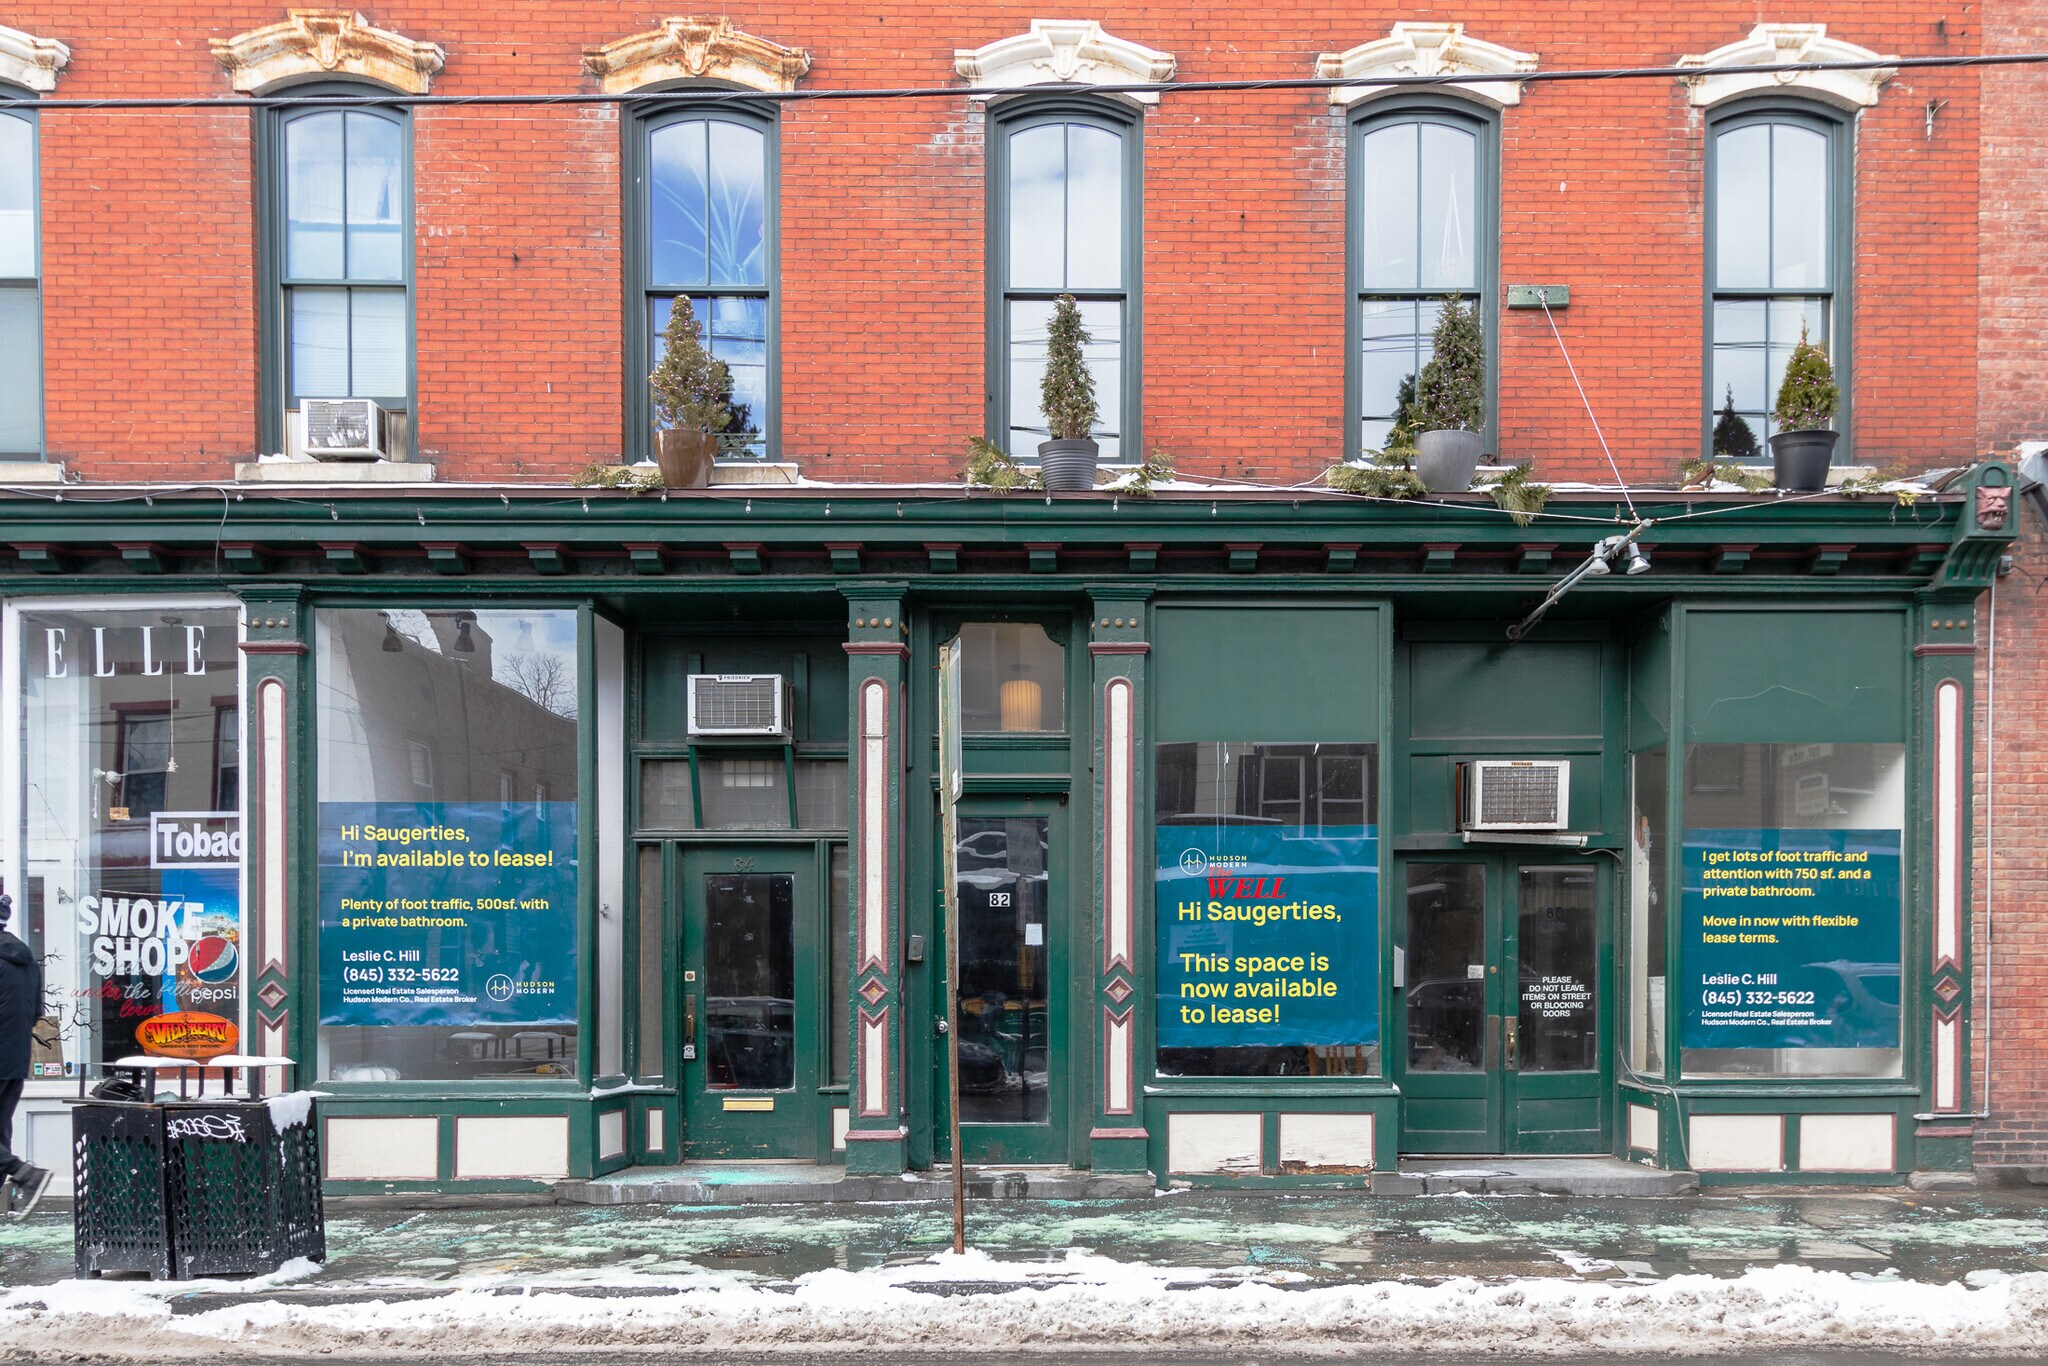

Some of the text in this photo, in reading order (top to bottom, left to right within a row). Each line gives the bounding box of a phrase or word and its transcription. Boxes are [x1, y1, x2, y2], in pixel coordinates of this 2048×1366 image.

[45, 625, 206, 677] ELLE
[341, 825, 469, 845] Hi Saugerties,
[343, 850, 553, 867] I'm available to lease!
[1703, 851, 1868, 864] I get lots of foot traffic and
[1703, 868, 1871, 879] attention with 750 sf. and a
[1207, 878, 1286, 898] WELL
[1703, 885, 1815, 899] private bathroom.
[341, 899, 549, 912] Plenty of foot traffic, 500sf. with
[991, 894, 1009, 906] 82
[79, 896, 204, 940] SMOKE
[1178, 901, 1341, 926] Hi Saugerties,
[1703, 915, 1858, 926] Move in now with flexible
[342, 916, 467, 929] a private bathroom.
[1703, 933, 1778, 943] lease terms.
[94, 936, 189, 976] SHOP
[343, 950, 419, 961] Leslie C. Hill
[1180, 952, 1329, 977] This space is
[344, 966, 458, 983] (845) 332-5622
[1703, 974, 1777, 985] Leslie C. Hill
[124, 981, 151, 998] the
[191, 986, 237, 1002] pepsi
[416, 988, 459, 996] Salesperson
[1181, 978, 1337, 997] now available
[1702, 991, 1814, 1006] (845) 332-5622
[1181, 1005, 1280, 1023] to lease!
[145, 1022, 227, 1044] WILD BERRY
